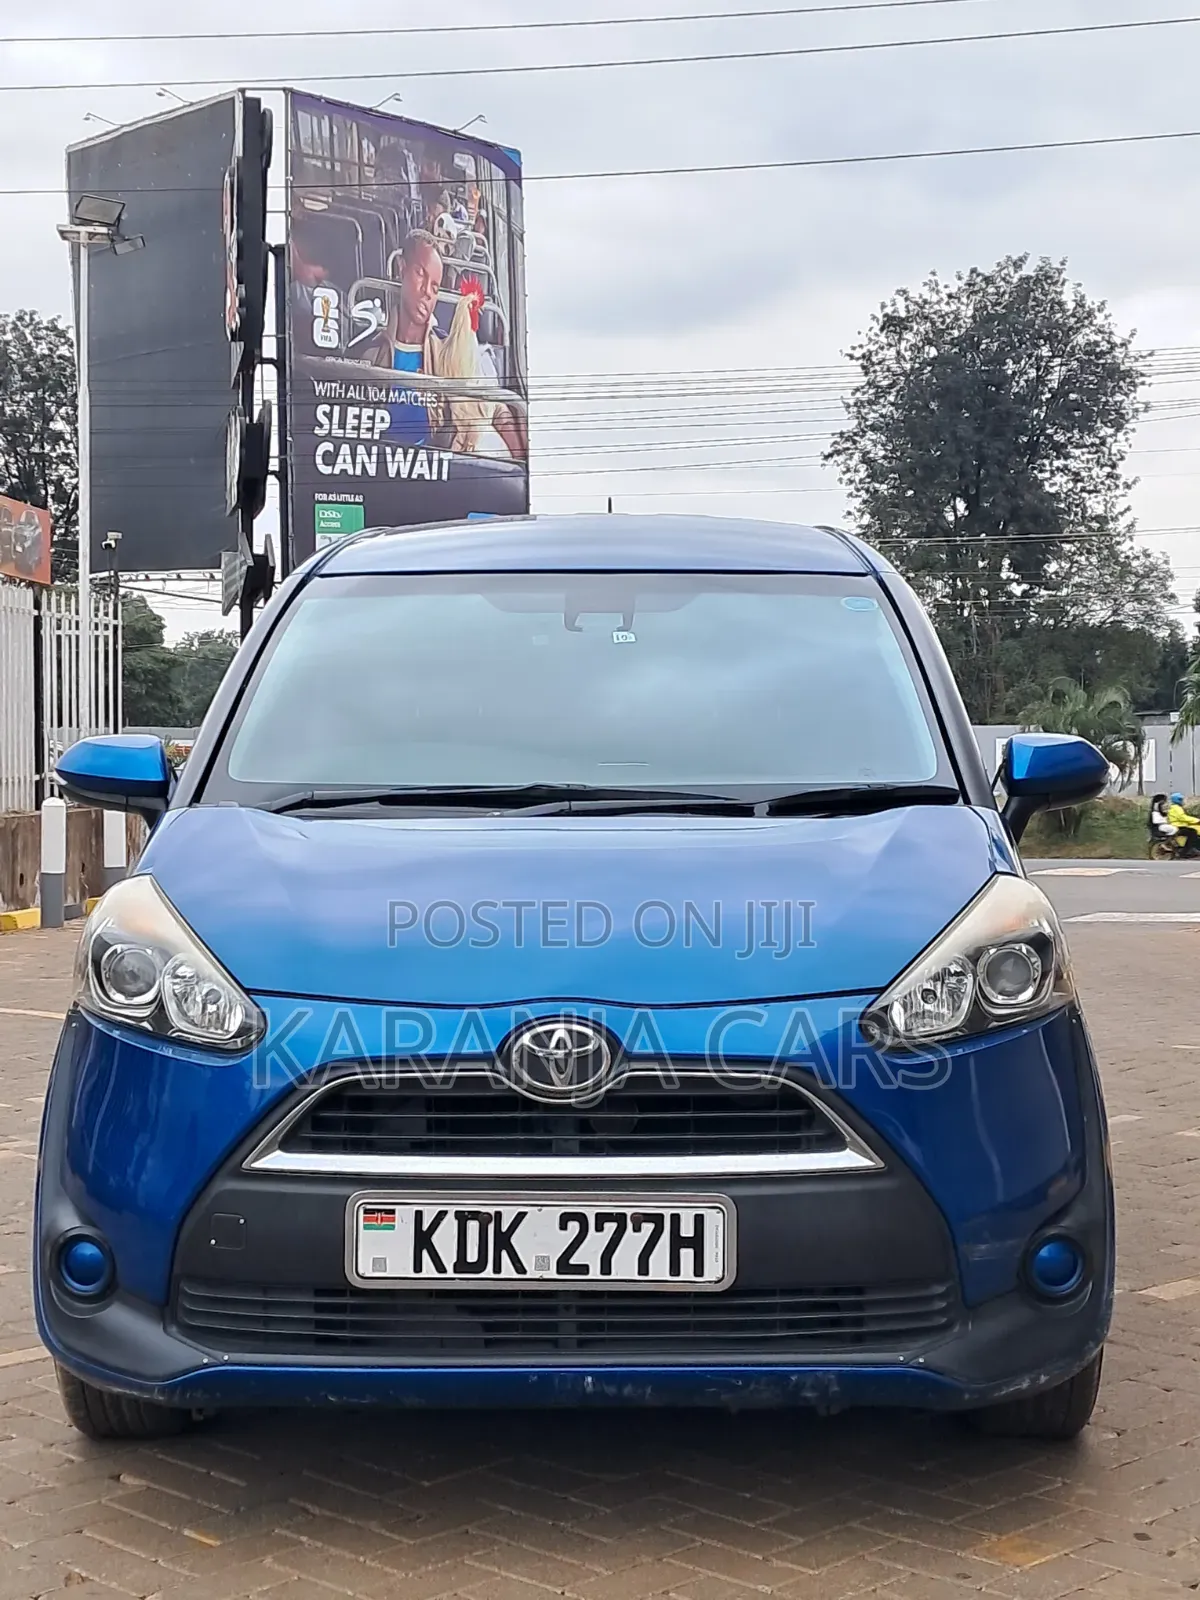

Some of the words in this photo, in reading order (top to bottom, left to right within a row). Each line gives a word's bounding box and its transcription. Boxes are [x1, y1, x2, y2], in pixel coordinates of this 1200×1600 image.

[314, 380, 345, 399] WITH
[346, 384, 366, 401] ALL
[368, 386, 387, 403] 104
[388, 388, 438, 408] MATCHES
[313, 403, 392, 440] SLEEP
[314, 442, 378, 477] CAN
[386, 446, 454, 483] WAIT
[314, 492, 328, 501] FOR
[328, 493, 337, 501] AS
[337, 493, 355, 502] LITTLE
[412, 1209, 529, 1275] KDK
[556, 1211, 706, 1278] 277H
